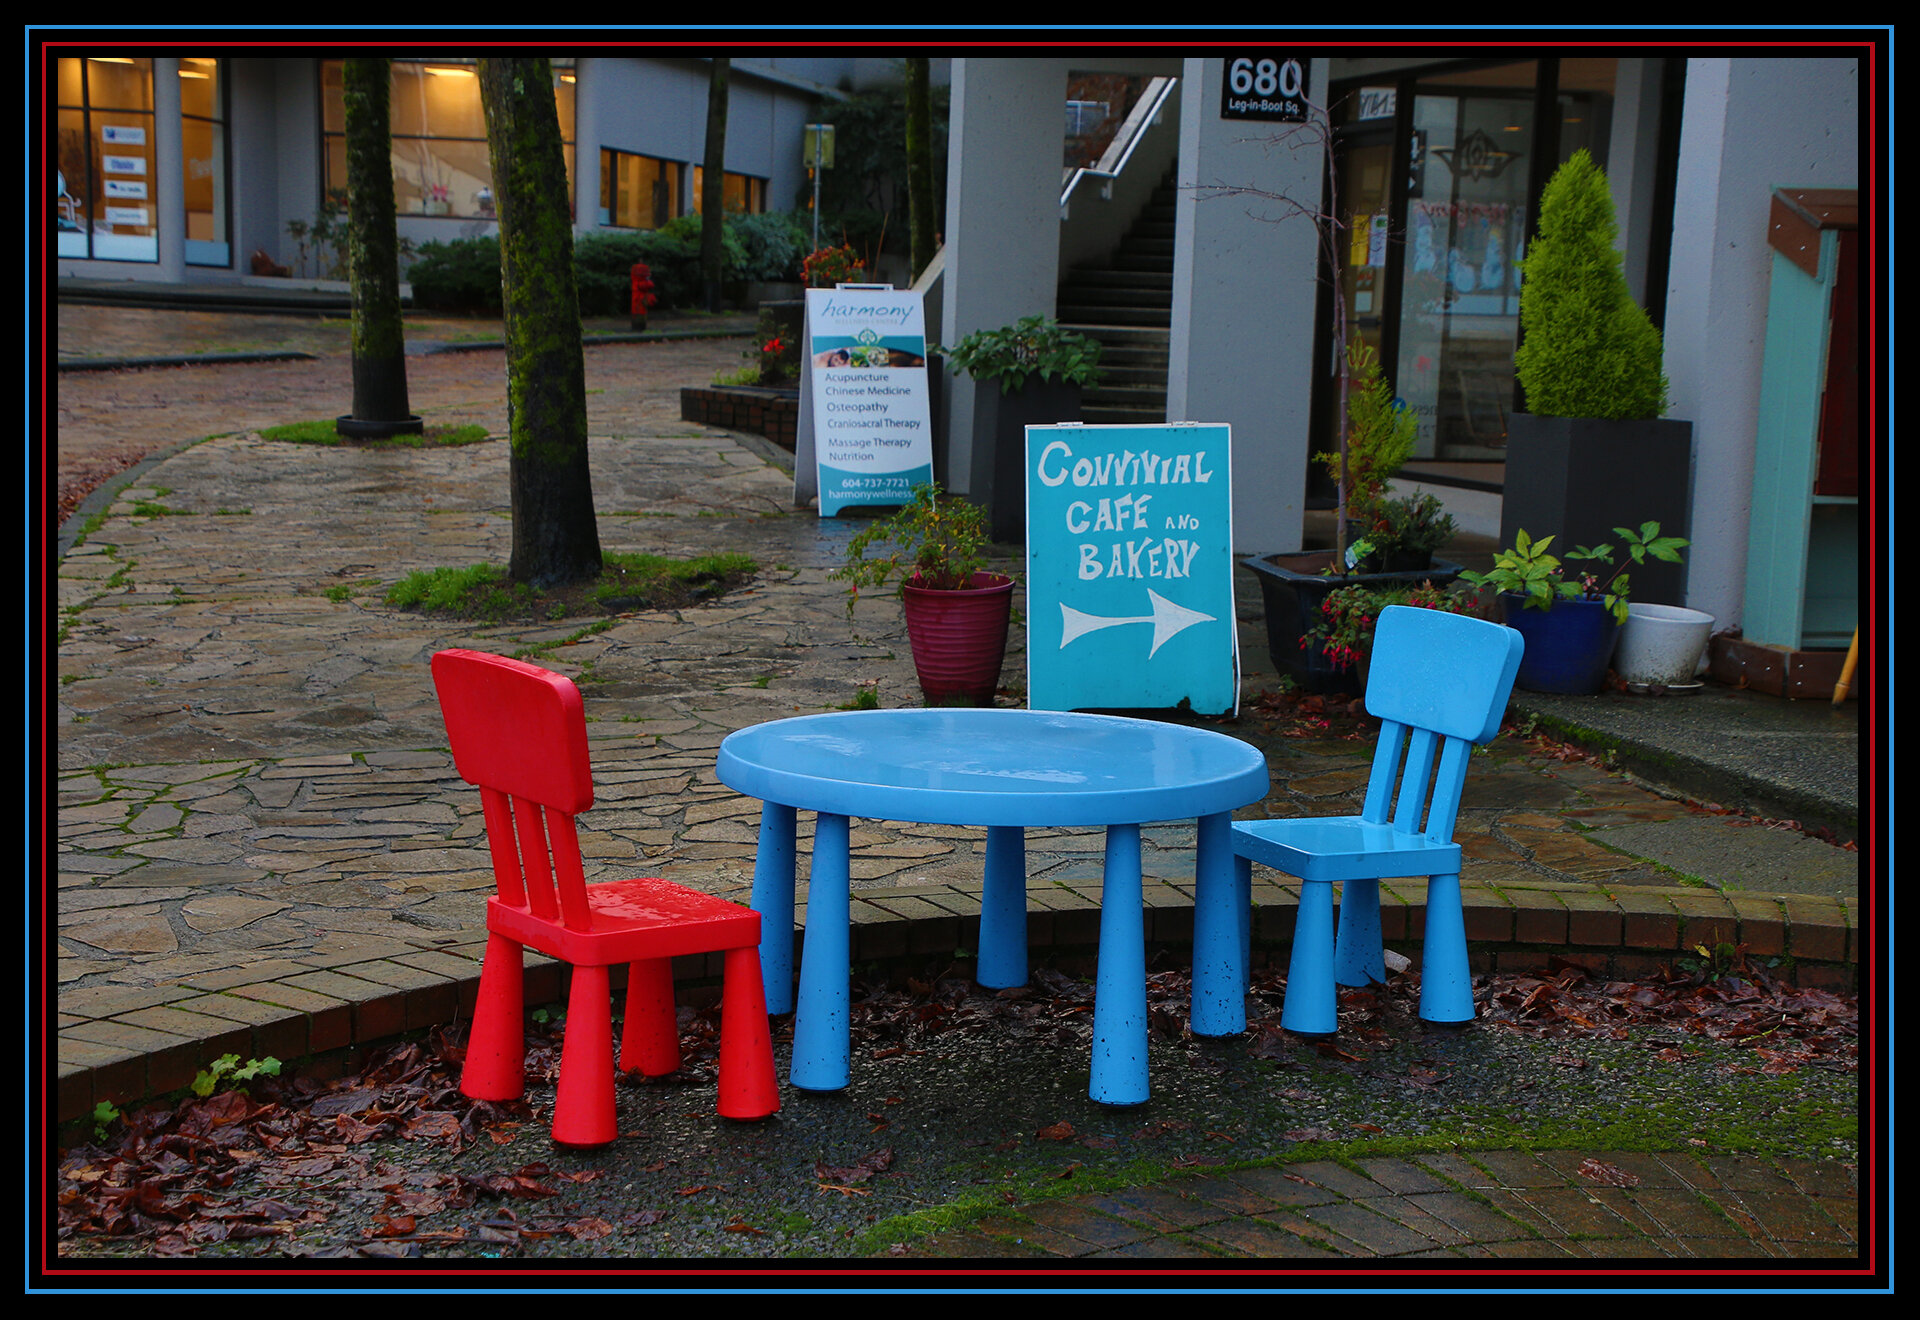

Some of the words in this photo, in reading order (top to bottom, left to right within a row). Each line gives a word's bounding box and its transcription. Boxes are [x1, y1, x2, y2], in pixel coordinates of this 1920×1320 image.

[1230, 58, 1303, 97] 680
[1229, 98, 1283, 112] Leg-in-Boot
[1285, 101, 1300, 114] Sq.
[822, 298, 914, 325] harmony
[825, 373, 889, 383] Acupuncture
[825, 386, 865, 396] Chinese
[867, 386, 911, 396] Medicine
[826, 402, 889, 413] Osteopathy
[827, 418, 883, 429] Craniosacral
[884, 418, 921, 429] Therapy
[828, 438, 872, 449] Massage
[873, 437, 912, 448] Therapy
[829, 452, 874, 461] Nutrition
[1037, 441, 1213, 487] CONVIVIAL
[841, 478, 910, 489] 604-737-7721
[1066, 493, 1152, 534] CAFE
[1165, 514, 1200, 531] AND
[1078, 537, 1201, 580] BAKERY
